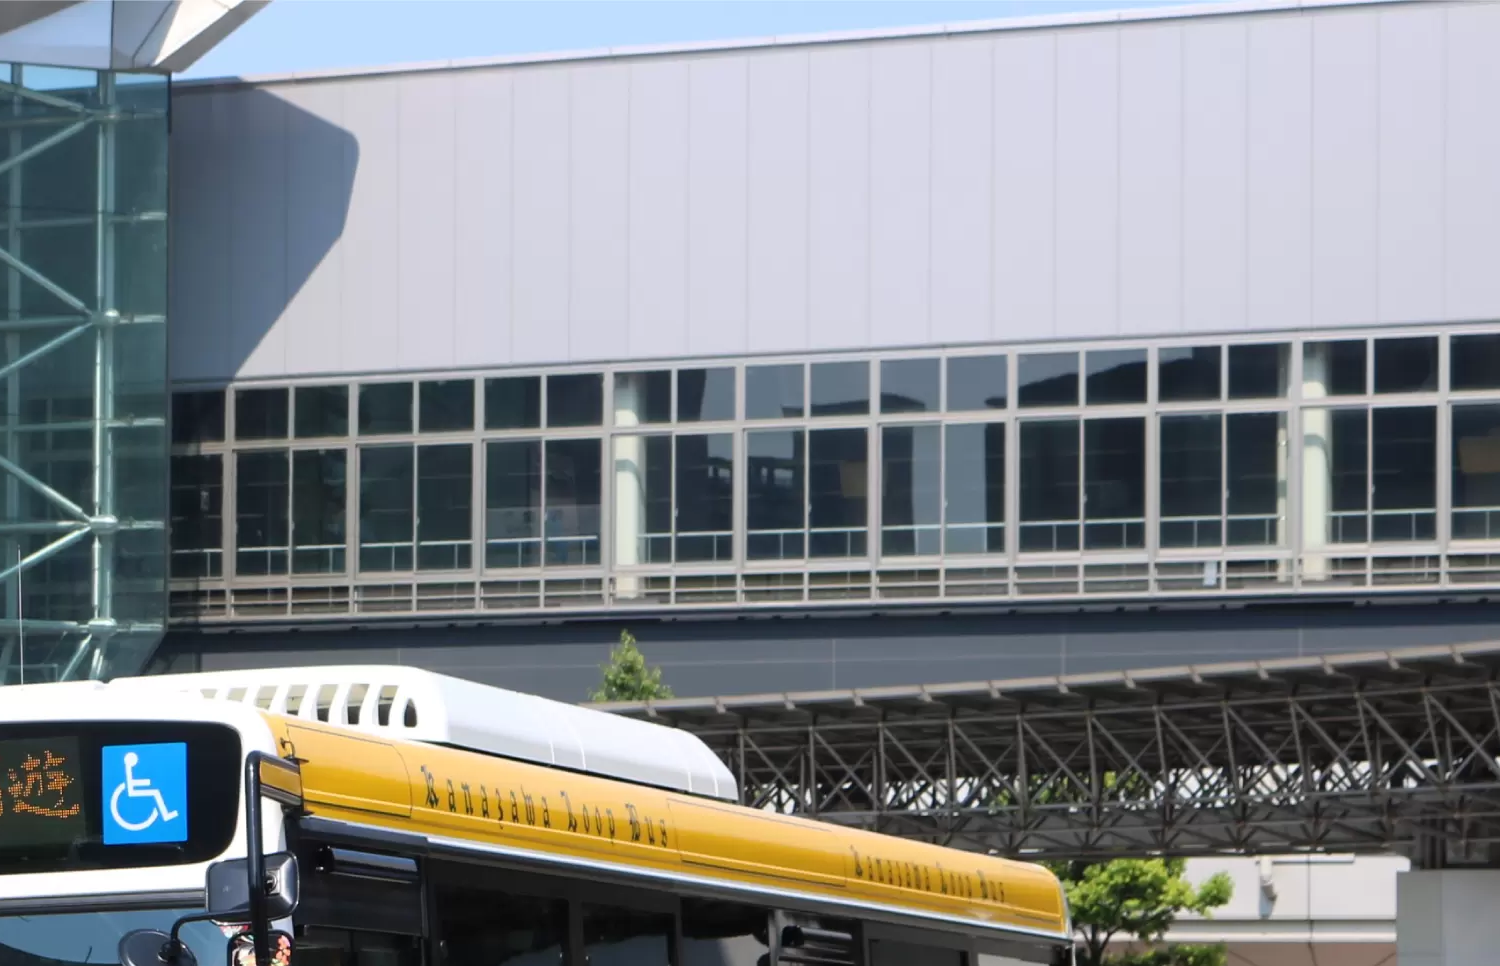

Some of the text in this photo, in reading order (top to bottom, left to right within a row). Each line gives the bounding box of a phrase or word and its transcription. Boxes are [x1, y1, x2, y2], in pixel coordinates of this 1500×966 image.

[420, 764, 668, 848] Kanazawa Loop Bus
